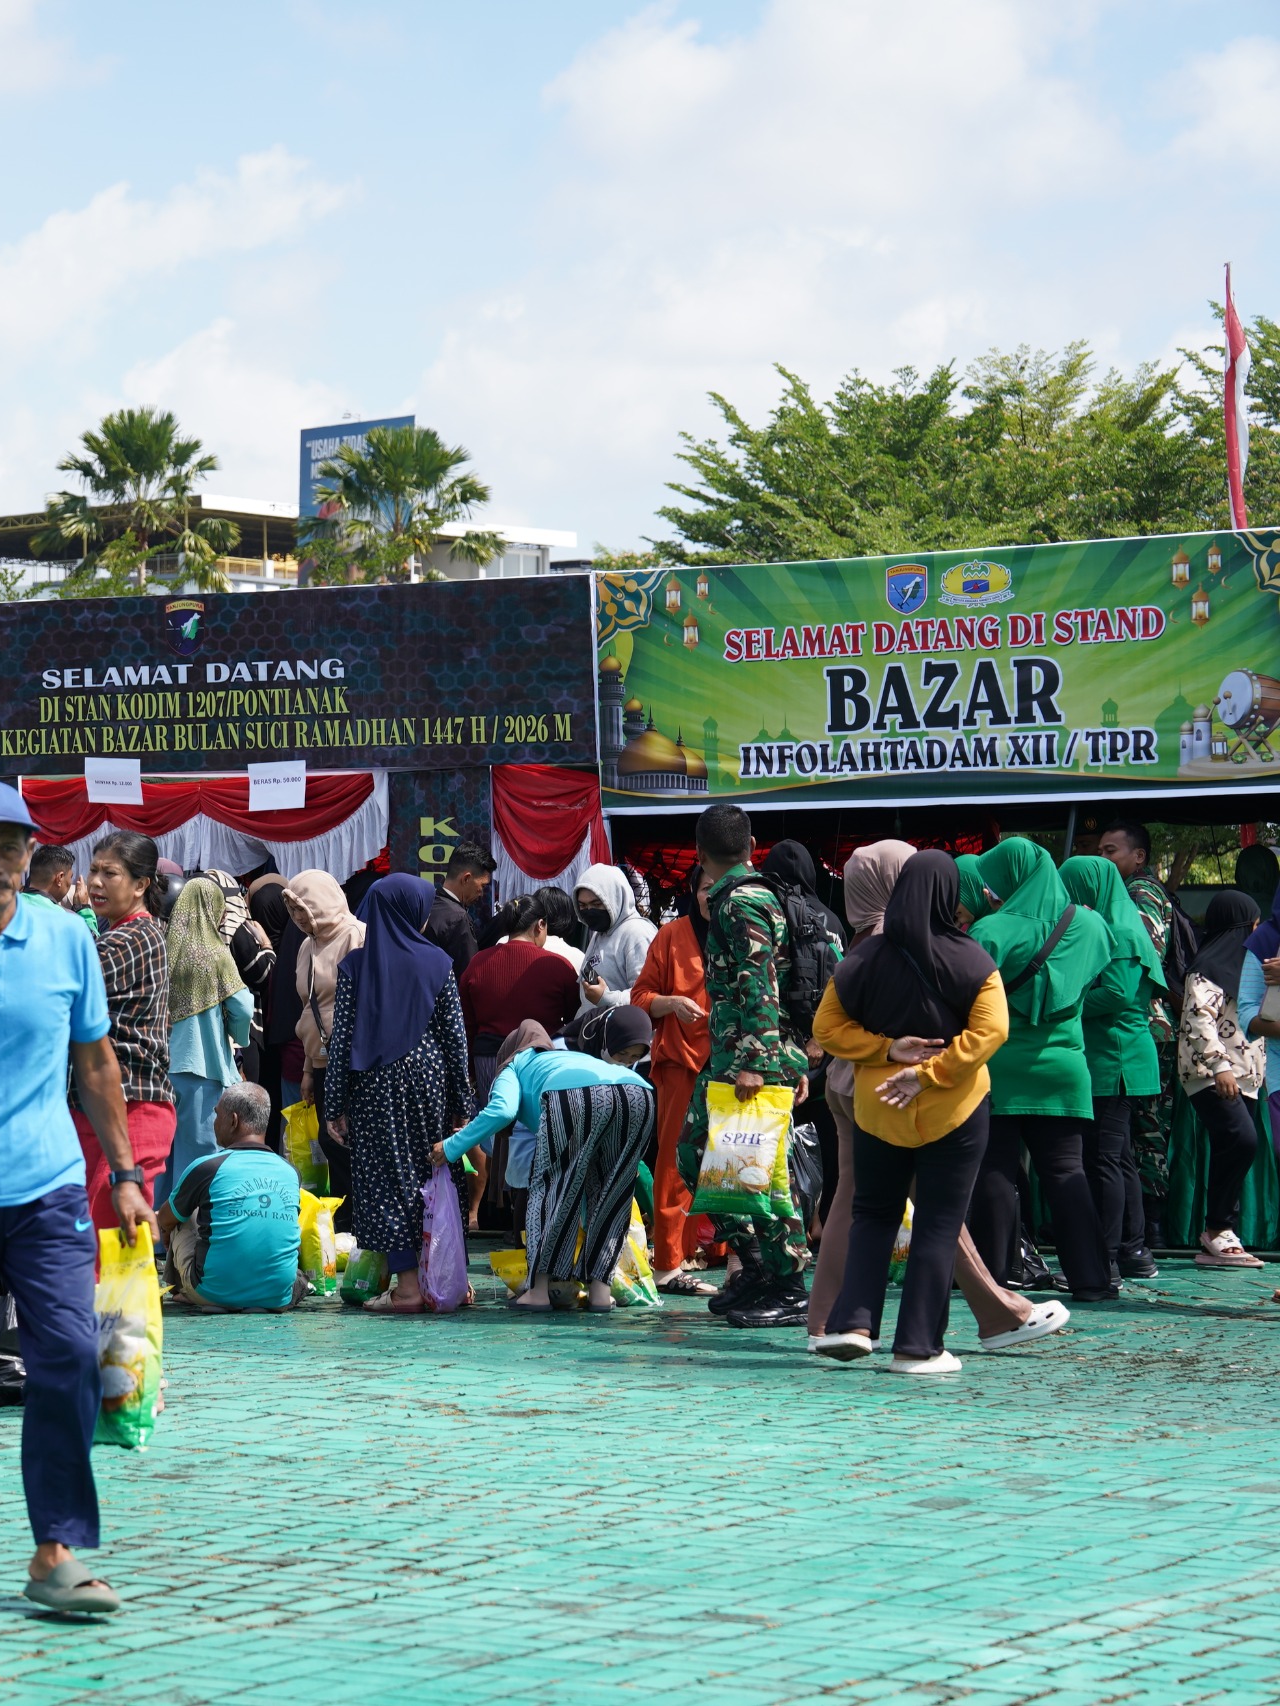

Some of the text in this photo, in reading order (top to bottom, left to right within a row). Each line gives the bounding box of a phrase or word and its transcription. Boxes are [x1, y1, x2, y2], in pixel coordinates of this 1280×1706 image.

[724, 606, 1165, 661] SELAMAT DATANG DI STAND
[42, 658, 345, 690] SELAMAT DATANG
[39, 686, 350, 723] DI STAN KODIM 1207/PONTIANAK
[825, 657, 1063, 733] BAZAR
[1, 726, 97, 756] KEGIATAN
[101, 724, 169, 753] BAZAR
[173, 722, 240, 751] BULAN
[245, 720, 289, 749] SUCI
[294, 717, 416, 748] RAMADHAN
[421, 716, 465, 745] 1447
[470, 716, 487, 744] H
[492, 715, 499, 744] /
[504, 714, 548, 743] 2026
[553, 713, 572, 742] M
[740, 727, 1158, 777] INFOLAHTADAM XII / TPR
[722, 1132, 767, 1146] SPHP
[228, 1209, 295, 1222] SUNGAI RAYA
[258, 1194, 271, 1209] 9
